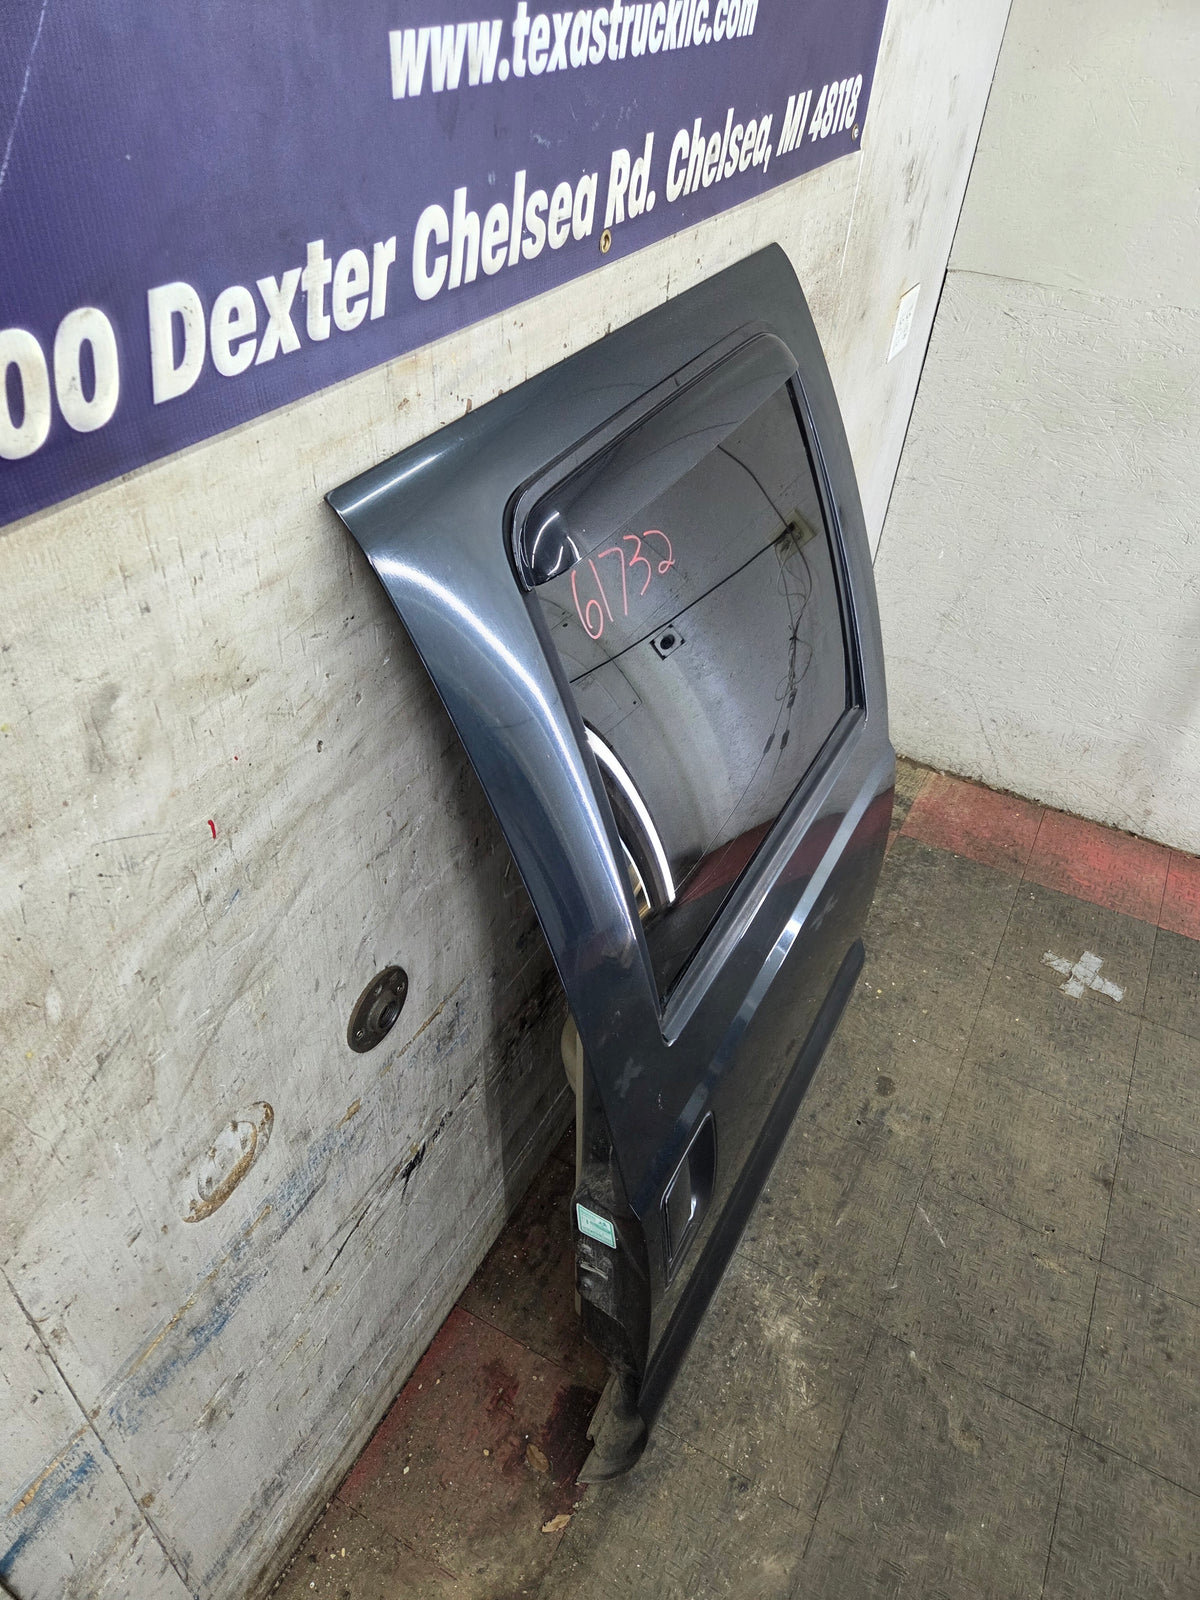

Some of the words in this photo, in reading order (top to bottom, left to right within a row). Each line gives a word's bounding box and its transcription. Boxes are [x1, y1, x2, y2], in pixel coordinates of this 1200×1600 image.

[389, 0, 758, 99] www.texastruckllc.com
[148, 237, 396, 405] Dexter
[413, 170, 599, 301] Chelsea
[604, 131, 656, 229] Rd.
[666, 107, 773, 202] Chelsea,
[776, 89, 812, 157] MI
[808, 73, 862, 142] 48118
[571, 530, 676, 640] 61732
